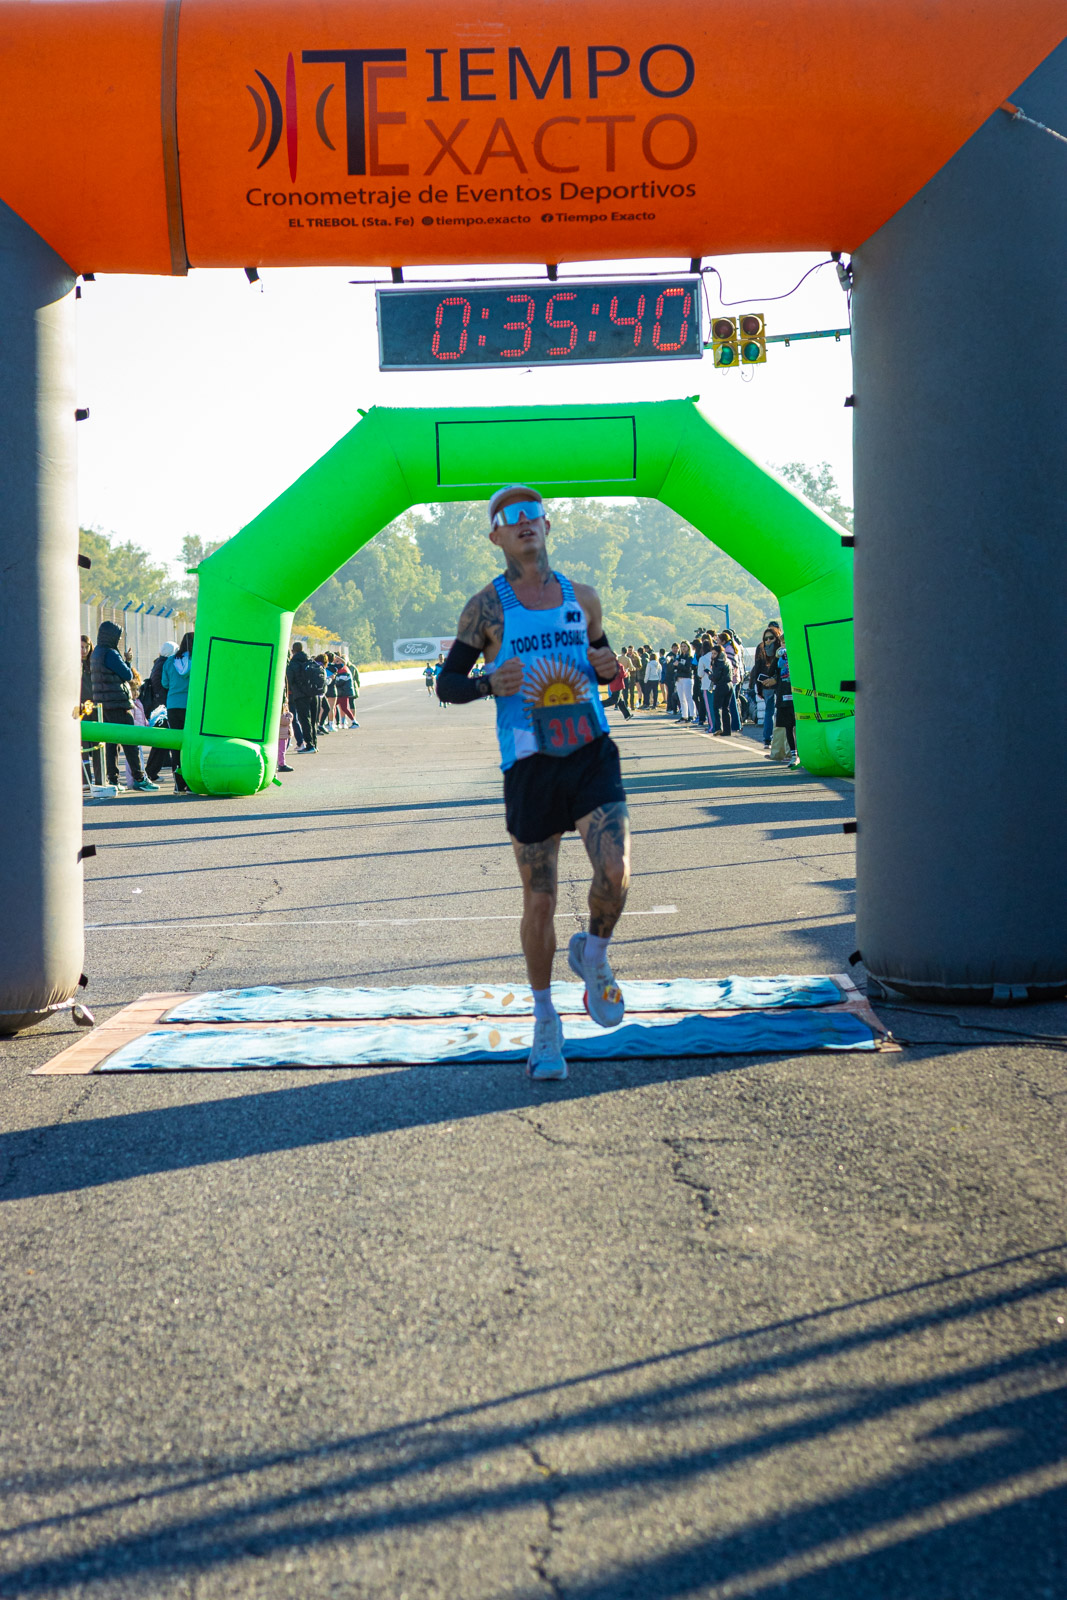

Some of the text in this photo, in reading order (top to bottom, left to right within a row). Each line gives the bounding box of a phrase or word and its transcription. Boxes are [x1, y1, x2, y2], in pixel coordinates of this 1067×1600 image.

[246, 180, 697, 208] Cronometraje de Eventos Deportivos
[289, 211, 656, 228] EL TREBOL (Sta. Fe) tiempo.exacto Tiempo Exacto
[431, 287, 692, 360] 0:35:40
[404, 643, 428, 654] Ford
[510, 634, 539, 656] TODO
[541, 631, 553, 650] ES
[549, 715, 594, 748] 314
